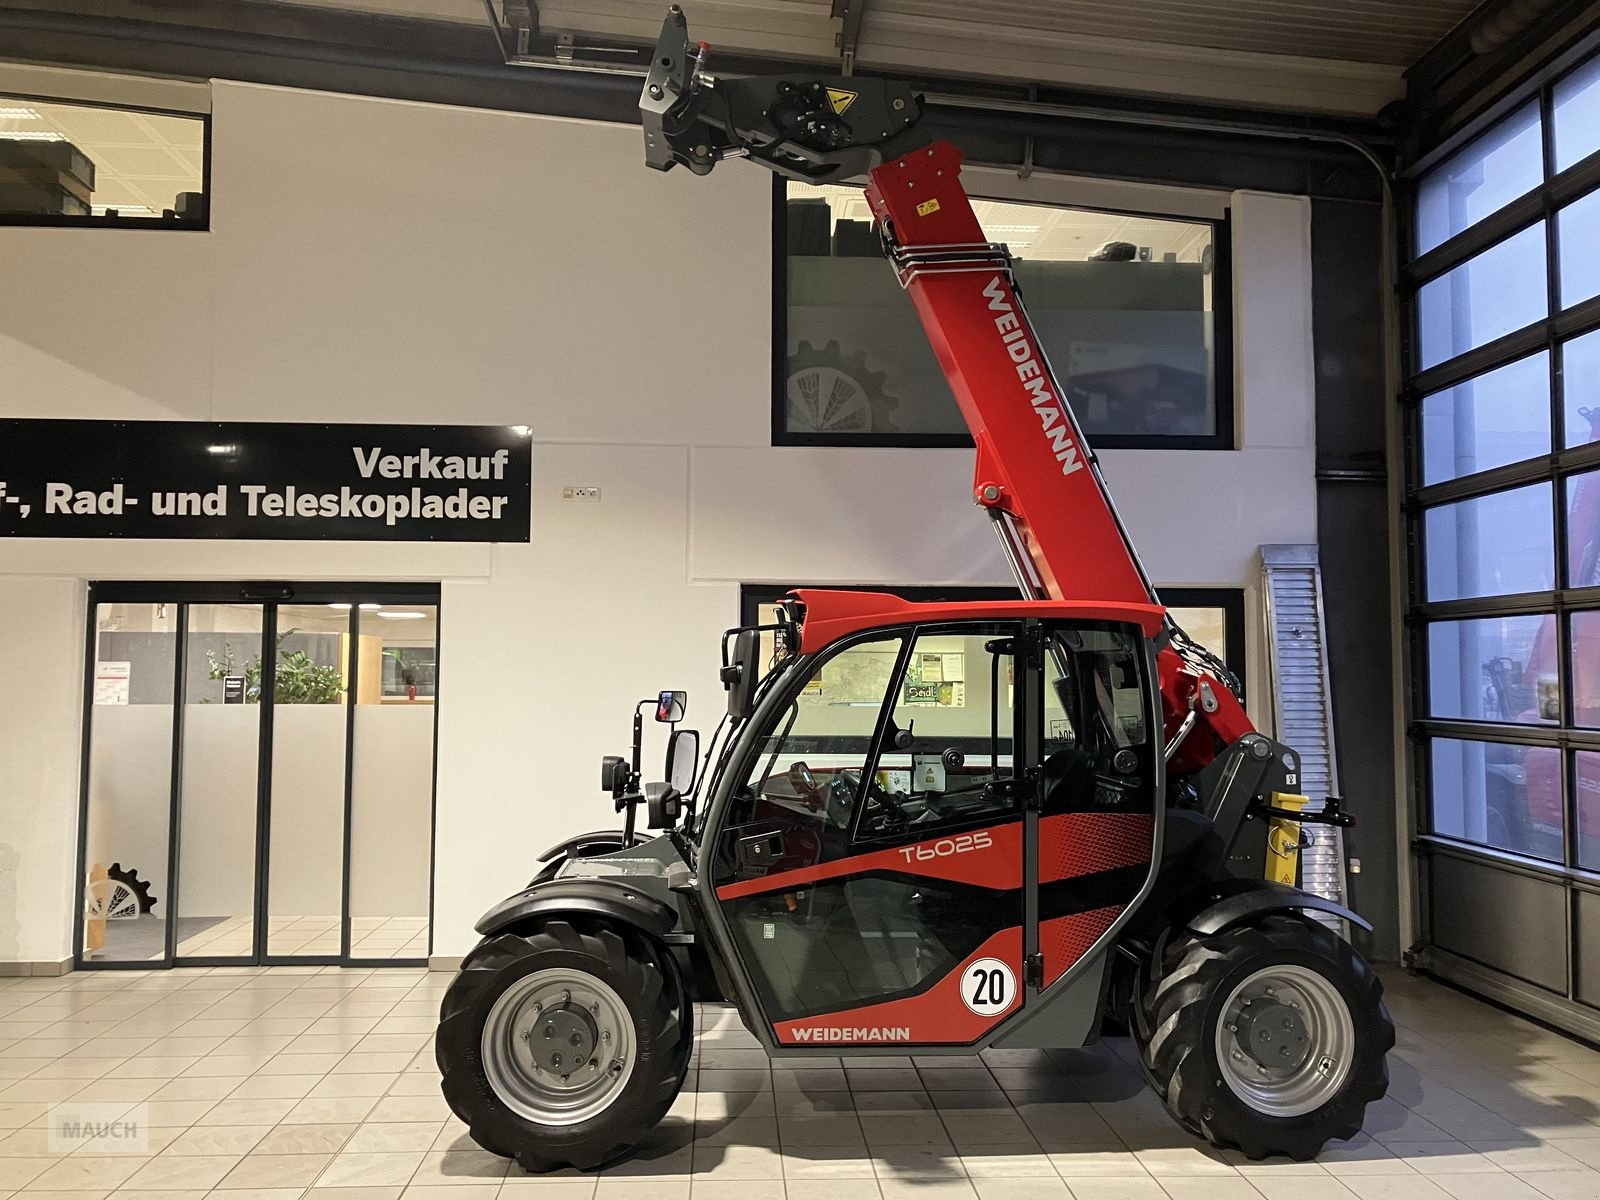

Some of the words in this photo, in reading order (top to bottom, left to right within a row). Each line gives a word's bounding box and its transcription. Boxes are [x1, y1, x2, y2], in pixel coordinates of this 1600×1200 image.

[983, 276, 1083, 475] WEIDEMANN
[353, 447, 508, 480] Verkauf
[45, 482, 138, 515] Rad-
[151, 485, 227, 516] und
[240, 485, 508, 525] Teleskoplader
[899, 832, 993, 863] T6025
[972, 969, 1004, 1005] 20
[791, 1027, 910, 1041] WEIDEMANN
